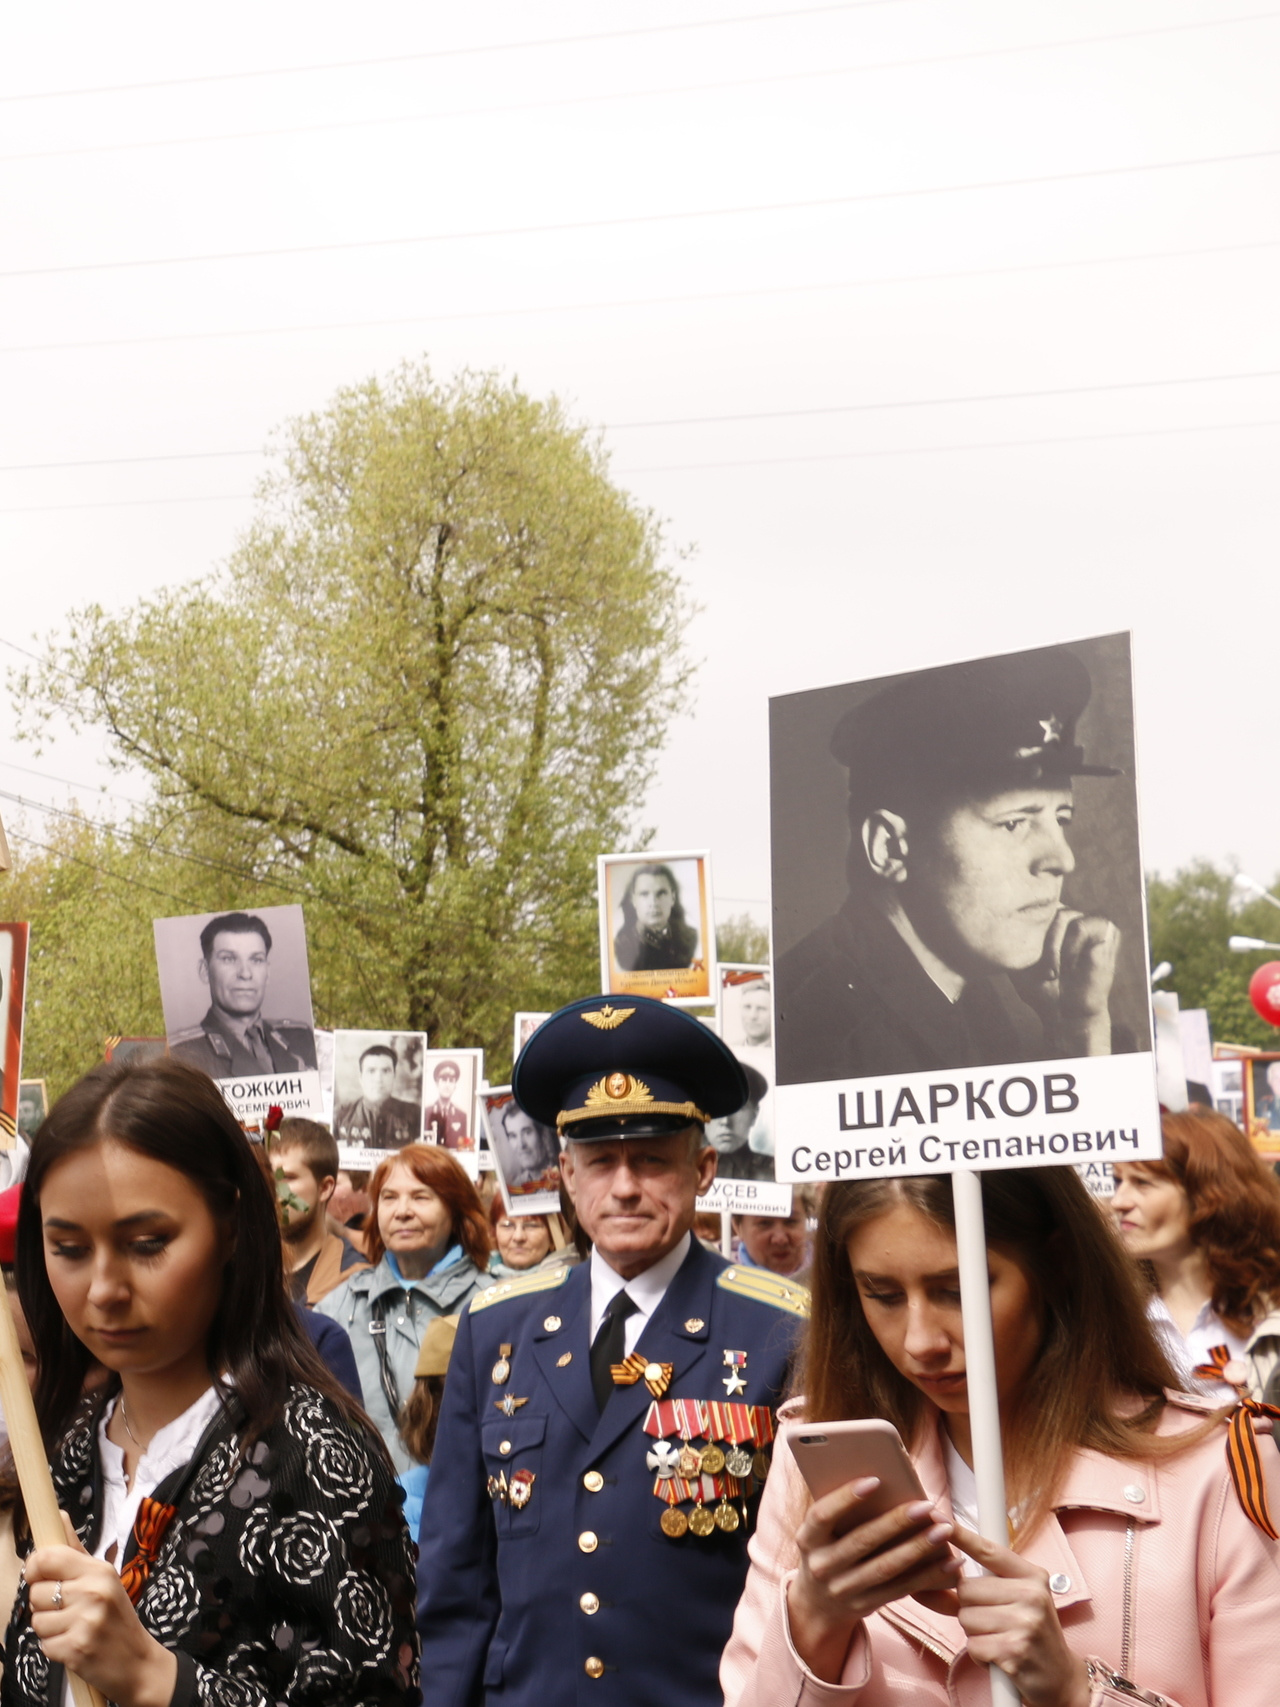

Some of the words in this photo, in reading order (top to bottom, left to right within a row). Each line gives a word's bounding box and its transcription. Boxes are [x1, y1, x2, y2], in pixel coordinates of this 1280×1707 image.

[221, 1078, 302, 1099] ГОЖКИН
[838, 1073, 1080, 1132] ШАРКОВ
[791, 1138, 907, 1177] Сергей
[919, 1128, 1140, 1163] Степанович
[711, 1183, 757, 1199] УСЕВ
[726, 1199, 787, 1214] Иванович
